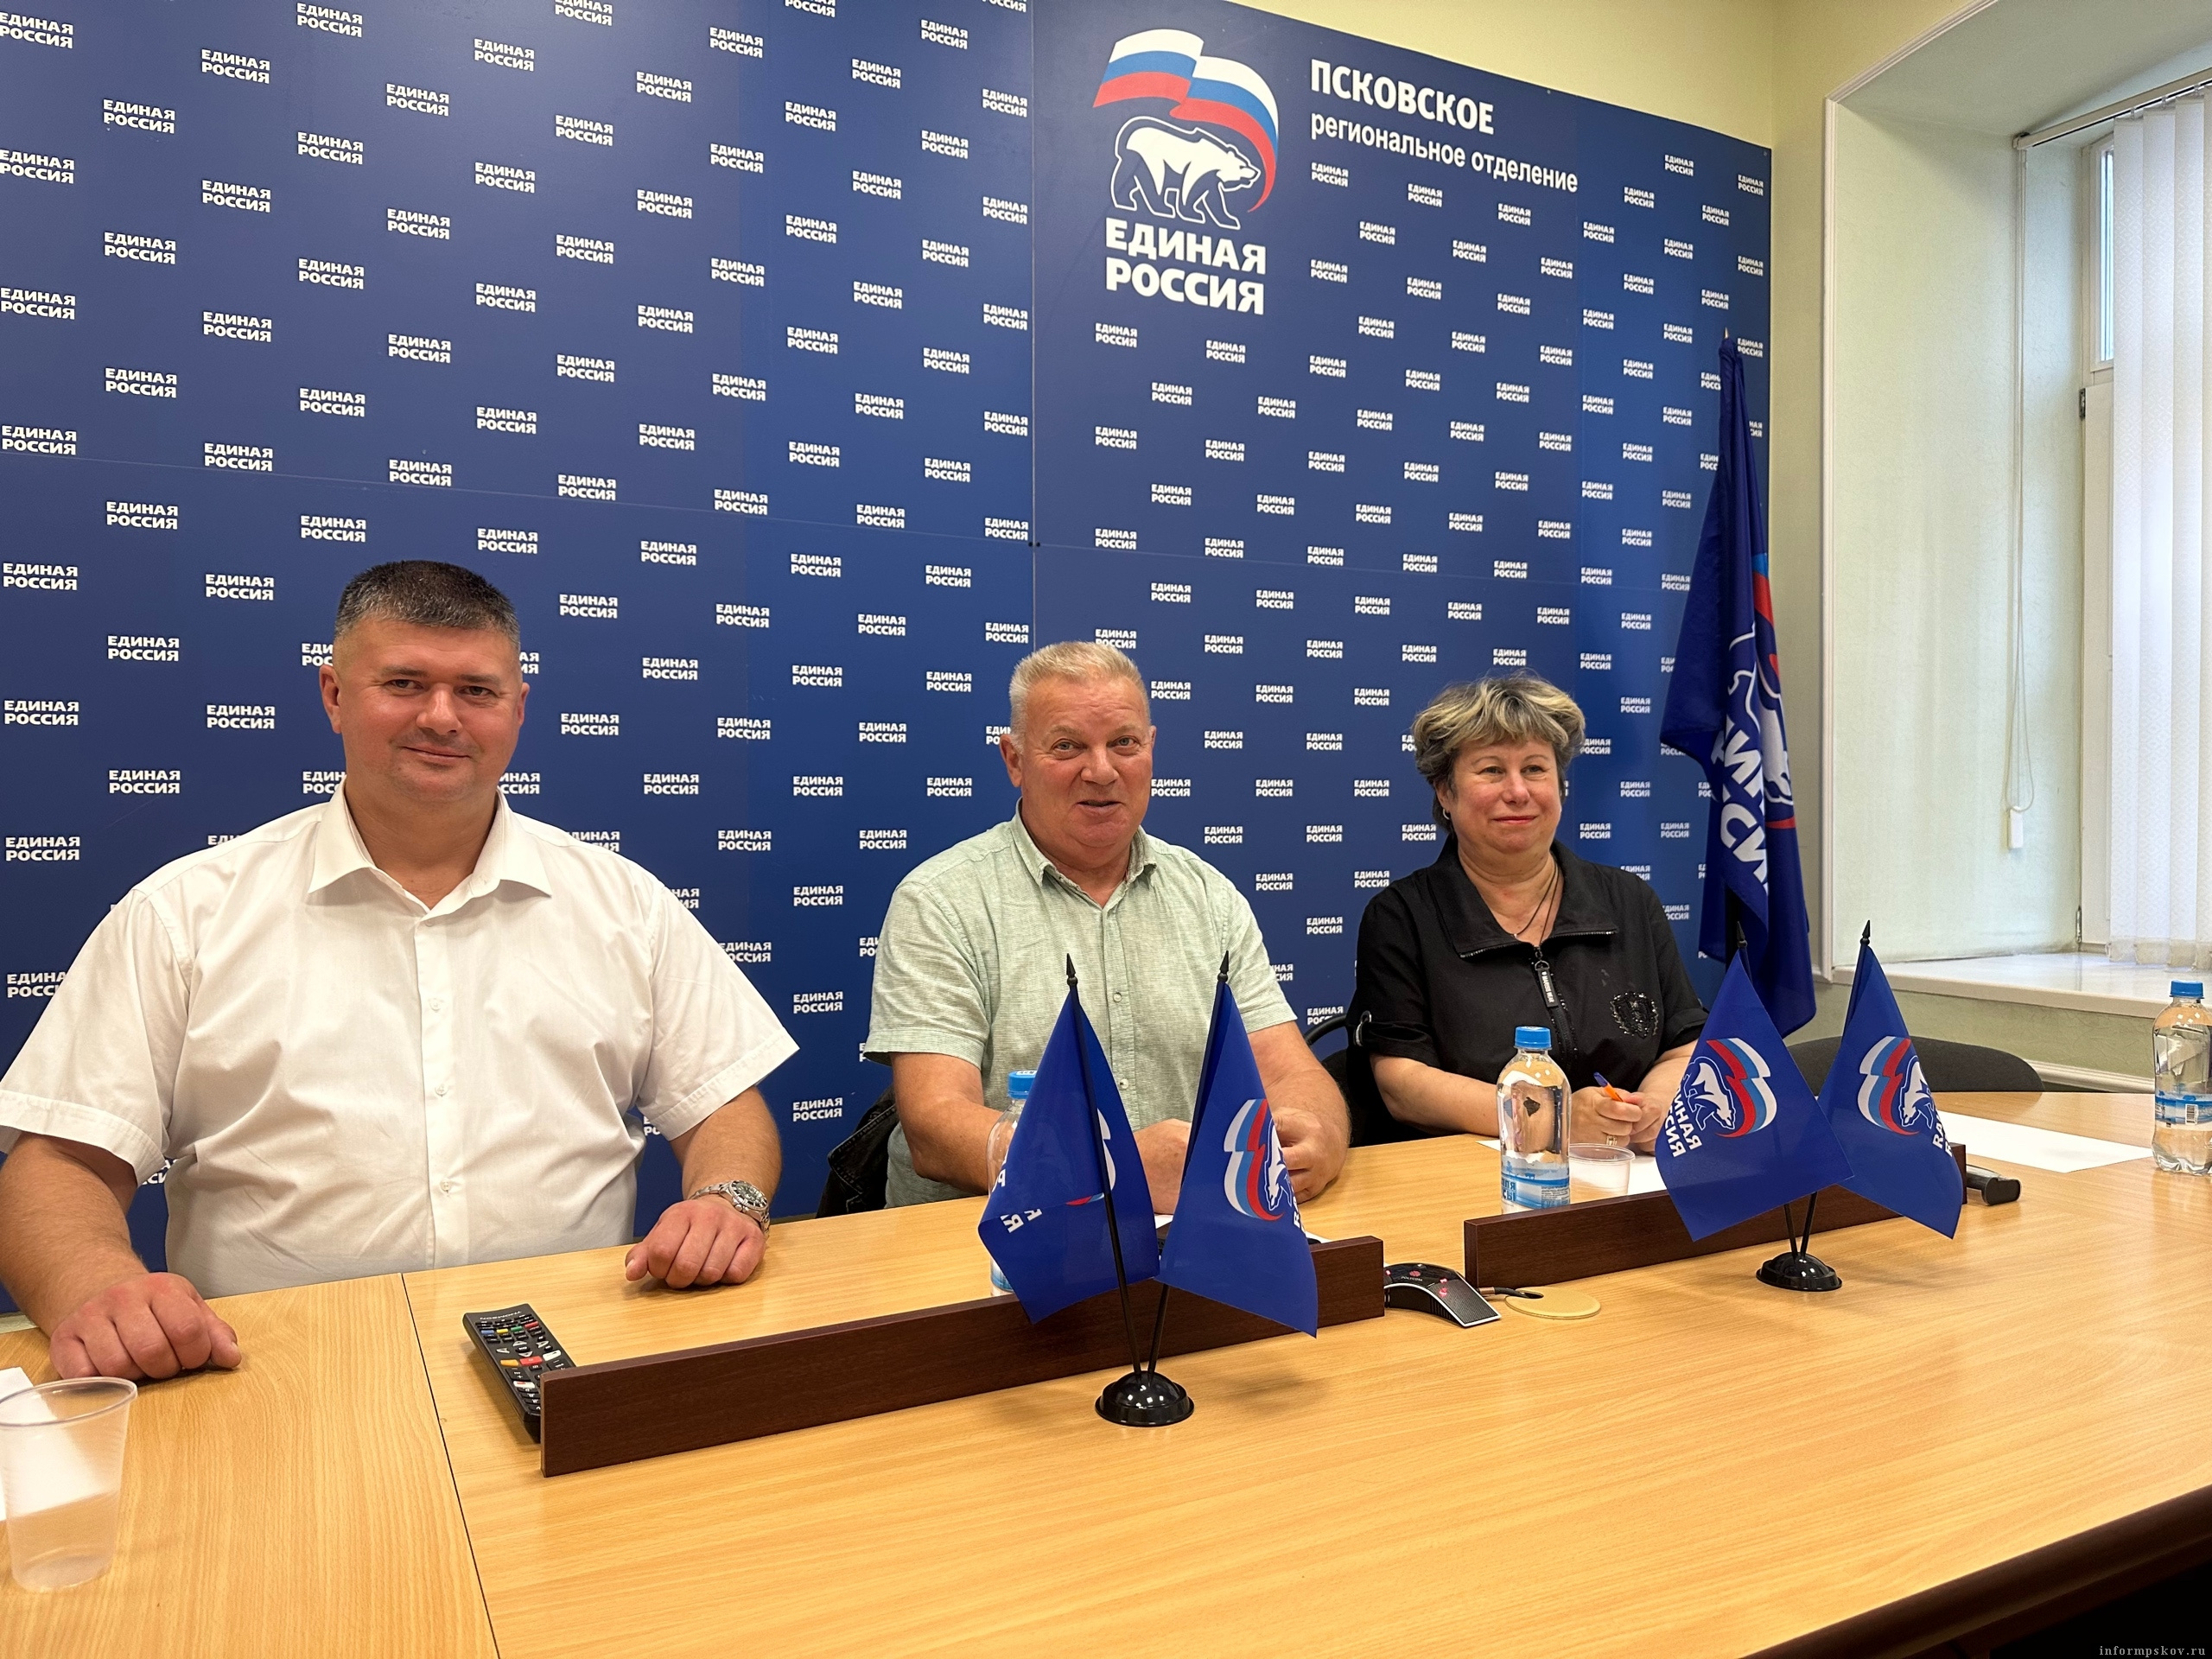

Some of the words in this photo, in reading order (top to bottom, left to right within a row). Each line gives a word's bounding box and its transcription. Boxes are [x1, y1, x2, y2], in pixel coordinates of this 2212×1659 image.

[297, 3, 363, 25] ЕДИНАЯ
[297, 15, 362, 37] РОССИЯ
[921, 20, 968, 39] ЕДИНАЯ
[710, 27, 763, 47] ЕДИНАЯ
[921, 29, 968, 49] РОССИЯ
[474, 39, 534, 59] ЕДИНАЯ
[710, 38, 763, 58] РОССИЯ
[474, 50, 534, 72] РОССИЯ
[1311, 59, 1494, 135] ПСКОВСКОЕ
[104, 99, 175, 120] ЕДИНАЯ
[104, 112, 175, 134] РОССИЯ
[1311, 112, 1465, 167] региональное
[1471, 151, 1578, 192] отделение
[1312, 162, 1349, 177] ЕДИНАЯ
[853, 170, 901, 188] ЕДИНАЯ
[1312, 171, 1348, 188] РОССИЯ
[1738, 175, 1764, 188] ЕДИНАЯ
[202, 180, 270, 200] ЕДИНАЯ
[853, 181, 901, 200] РОССИЯ
[1408, 183, 1442, 198] ЕДИНАЯ
[1624, 187, 1655, 200] ЕДИНАЯ
[1738, 182, 1764, 196] РОССИЯ
[202, 192, 270, 213] РОССИЯ
[637, 189, 692, 207] ЕДИНАЯ
[982, 196, 1027, 213] ЕДИНАЯ
[1408, 193, 1442, 207] РОССИЯ
[1624, 194, 1654, 208] РОССИЯ
[638, 200, 692, 219] РОССИЯ
[983, 207, 1027, 225] РОССИЯ
[387, 208, 450, 227] ЕДИНАЯ
[388, 220, 449, 239] РОССИЯ
[1106, 217, 1266, 275] ЕДИНАЯ
[1311, 259, 1348, 273] ЕДИНАЯ
[1541, 257, 1573, 270] ЕДИНАЯ
[1738, 256, 1764, 268] ЕДИНАЯ
[1311, 269, 1347, 283] РОССИЯ
[1541, 265, 1573, 279] РОССИЯ
[1738, 264, 1764, 276] РОССИЯ
[1106, 257, 1264, 315] РОССИЯ
[1407, 277, 1442, 290] ЕДИНАЯ
[1624, 274, 1654, 286] ЕДИНАЯ
[1407, 286, 1441, 300] РОССИЯ
[1624, 282, 1654, 295] РОССИЯ
[1, 288, 75, 306] ЕДИНАЯ
[1, 301, 75, 320] РОССИЯ
[638, 305, 693, 321] ЕДИНАЯ
[983, 303, 1028, 320] ЕДИНАЯ
[203, 312, 272, 329] ЕДИНАЯ
[638, 316, 693, 334] РОССИЯ
[983, 314, 1027, 330] РОССИЯ
[204, 324, 271, 342] РОССИЯ
[787, 327, 838, 343] ЕДИНАЯ
[1096, 323, 1137, 337] ЕДИНАЯ
[388, 334, 451, 351] ЕДИНАЯ
[787, 337, 838, 354] РОССИЯ
[1096, 333, 1137, 348] РОССИЯ
[1206, 340, 1246, 353] ЕДИНАЯ
[1738, 338, 1764, 349] ЕДИНАЯ
[389, 346, 450, 364] РОССИЯ
[1206, 349, 1245, 364] РОССИЯ
[1738, 346, 1763, 358] РОССИЯ
[1310, 355, 1346, 368] ЕДИНАЯ
[1310, 365, 1346, 378] РОССИЯ
[1583, 395, 1614, 406] ЕДИНАЯ
[1582, 403, 1613, 415] РОССИЯ
[1663, 407, 1692, 417] ЕДИНАЯ
[1451, 421, 1484, 432] ЕДИНАЯ
[1663, 415, 1692, 426] РОССИЯ
[2, 425, 77, 442] ЕДИНАЯ
[639, 424, 695, 439] ЕДИНАЯ
[1450, 429, 1484, 442] РОССИЯ
[2, 438, 76, 455] РОССИЯ
[639, 435, 695, 450] РОССИЯ
[205, 443, 273, 459] ЕДИНАЯ
[1308, 451, 1345, 462] ЕДИНАЯ
[205, 455, 272, 472] РОССИЯ
[389, 460, 452, 474] ЕДИНАЯ
[1308, 461, 1344, 473] РОССИЯ
[390, 471, 451, 486] РОССИЯ
[1152, 484, 1192, 496] ЕДИНАЯ
[1662, 490, 1691, 500] ЕДИНАЯ
[1152, 493, 1192, 505] РОССИЯ
[1662, 499, 1691, 509] РОССИЯ
[856, 505, 905, 518] ЕДИНАЯ
[1449, 512, 1483, 523] ЕДИНАЯ
[857, 514, 905, 529] РОССИЯ
[1449, 521, 1483, 532] РОССИЯ
[1538, 520, 1571, 530] ЕДИНАЯ
[1538, 529, 1570, 539] РОССИЯ
[1307, 546, 1344, 556] ЕДИНАЯ
[1307, 555, 1344, 566] РОССИЯ
[3, 563, 78, 577] ЕДИНАЯ
[3, 575, 77, 590] РОССИЯ
[206, 574, 274, 588] ЕДИНАЯ
[1662, 574, 1691, 582] ЕДИНАЯ
[1662, 582, 1690, 591] РОССИЯ
[206, 586, 274, 601] РОССИЯ
[560, 594, 618, 607] ЕДИНАЯ
[560, 605, 618, 619] РОССИЯ
[985, 622, 1029, 633] ЕДИНАЯ
[986, 632, 1028, 644] РОССИЯ
[1205, 635, 1243, 645] ЕДИНАЯ
[1205, 644, 1243, 654] РОССИЯ
[1493, 657, 1526, 666] РОССИЯ
[792, 665, 842, 676] ЕДИНАЯ
[792, 676, 842, 687] РОССИЯ
[1354, 688, 1389, 696] ЕДИНАЯ
[4, 700, 79, 712] ЕДИНАЯ
[1354, 696, 1389, 706] РОССИЯ
[207, 705, 275, 716] ЕДИНАЯ
[4, 713, 79, 726] РОССИЯ
[207, 717, 275, 729] РОССИЯ
[1205, 731, 1243, 740] ЕДИНАЯ
[1205, 740, 1243, 749] РОССИЯ
[644, 774, 699, 784] ЕДИНАЯ
[793, 776, 843, 786] ЕДИНАЯ
[927, 778, 972, 787] ЕДИНАЯ
[644, 785, 699, 795] РОССИЯ
[793, 786, 842, 796] РОССИЯ
[927, 787, 972, 797] РОССИЯ
[1354, 788, 1389, 797] РОССИЯ
[1205, 826, 1243, 835] ЕДИНАЯ
[1580, 823, 1611, 831] ЕДИНАЯ
[5, 836, 80, 849] ЕДИНАЯ
[1205, 835, 1243, 844] РОССИЯ
[6, 849, 79, 861] РОССИЯ
[1354, 871, 1389, 880] ЕДИНАЯ
[1355, 879, 1389, 888] РОССИЯ
[793, 886, 843, 896] ЕДИНАЯ
[793, 895, 842, 906] РОССИЯ
[793, 991, 843, 1003] ЕДИНАЯ
[793, 1001, 842, 1014] РОССИЯ
[793, 1097, 842, 1110] ЕДИНАЯ
[793, 1108, 842, 1122] РОССИЯ
[1674, 1087, 1702, 1150] ИНАЯ
[1664, 1105, 1686, 1157] СИЯ
